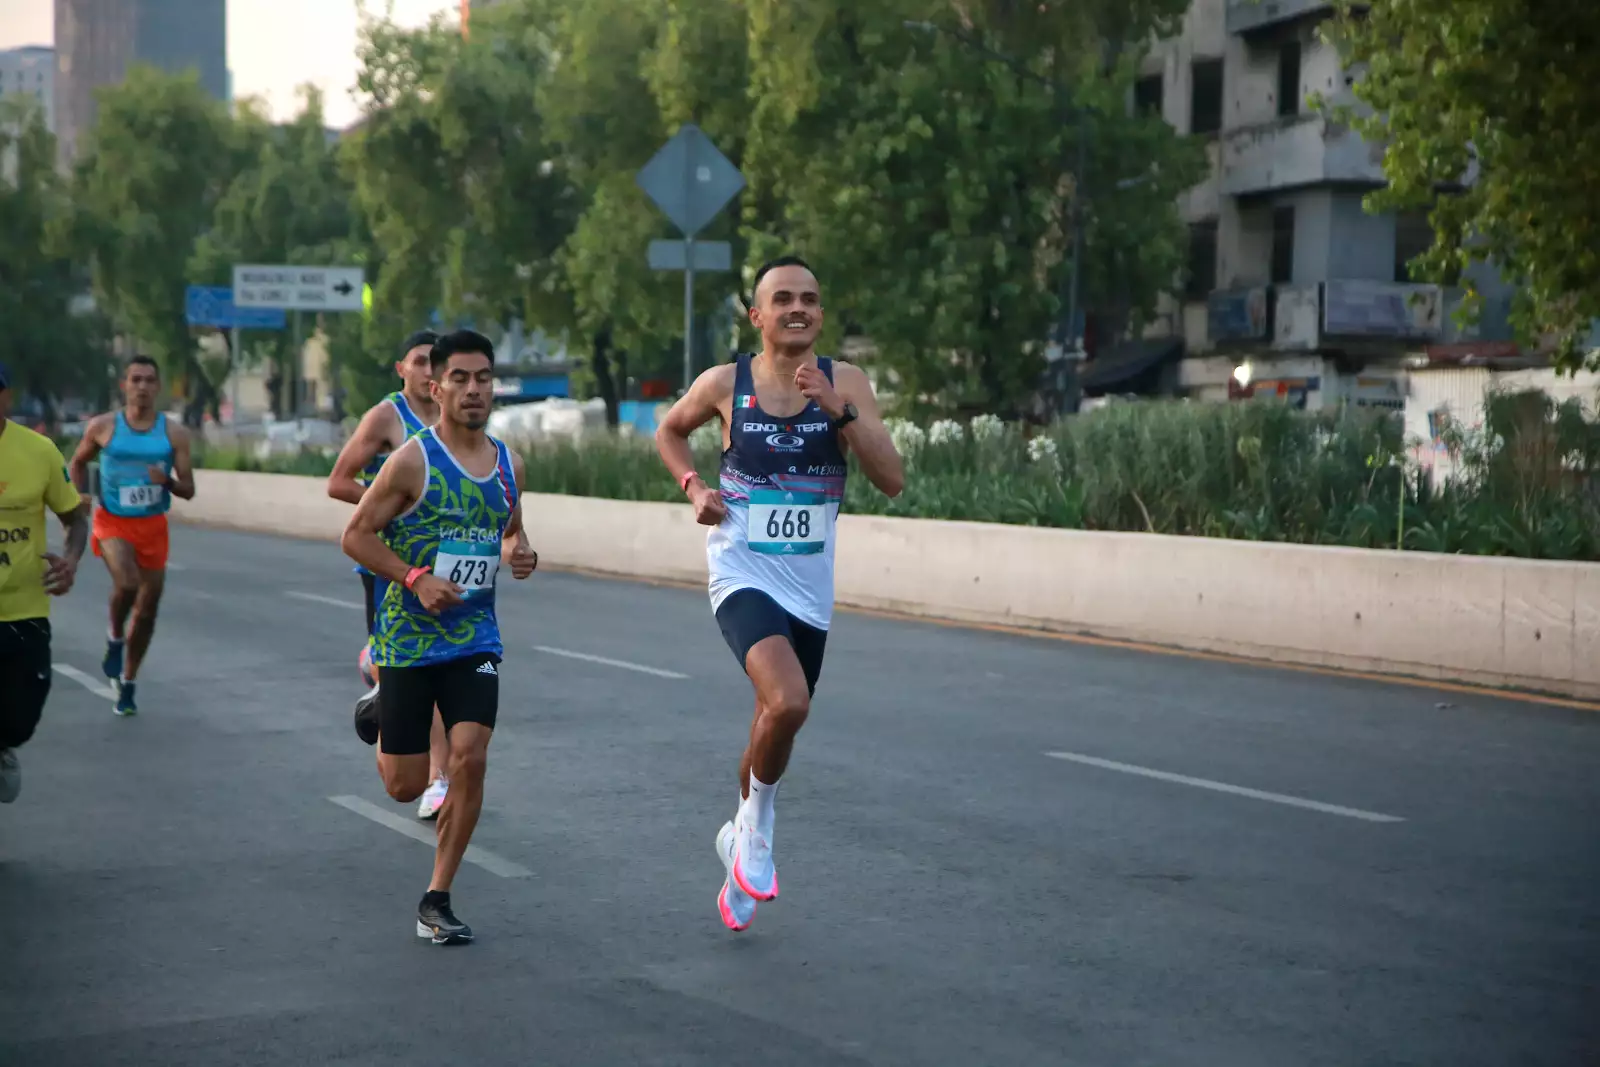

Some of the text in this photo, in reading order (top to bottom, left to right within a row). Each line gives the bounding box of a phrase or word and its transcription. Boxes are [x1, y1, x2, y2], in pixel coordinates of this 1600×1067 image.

[795, 421, 829, 433] TEAM
[766, 509, 811, 538] 668
[449, 559, 488, 586] 673
